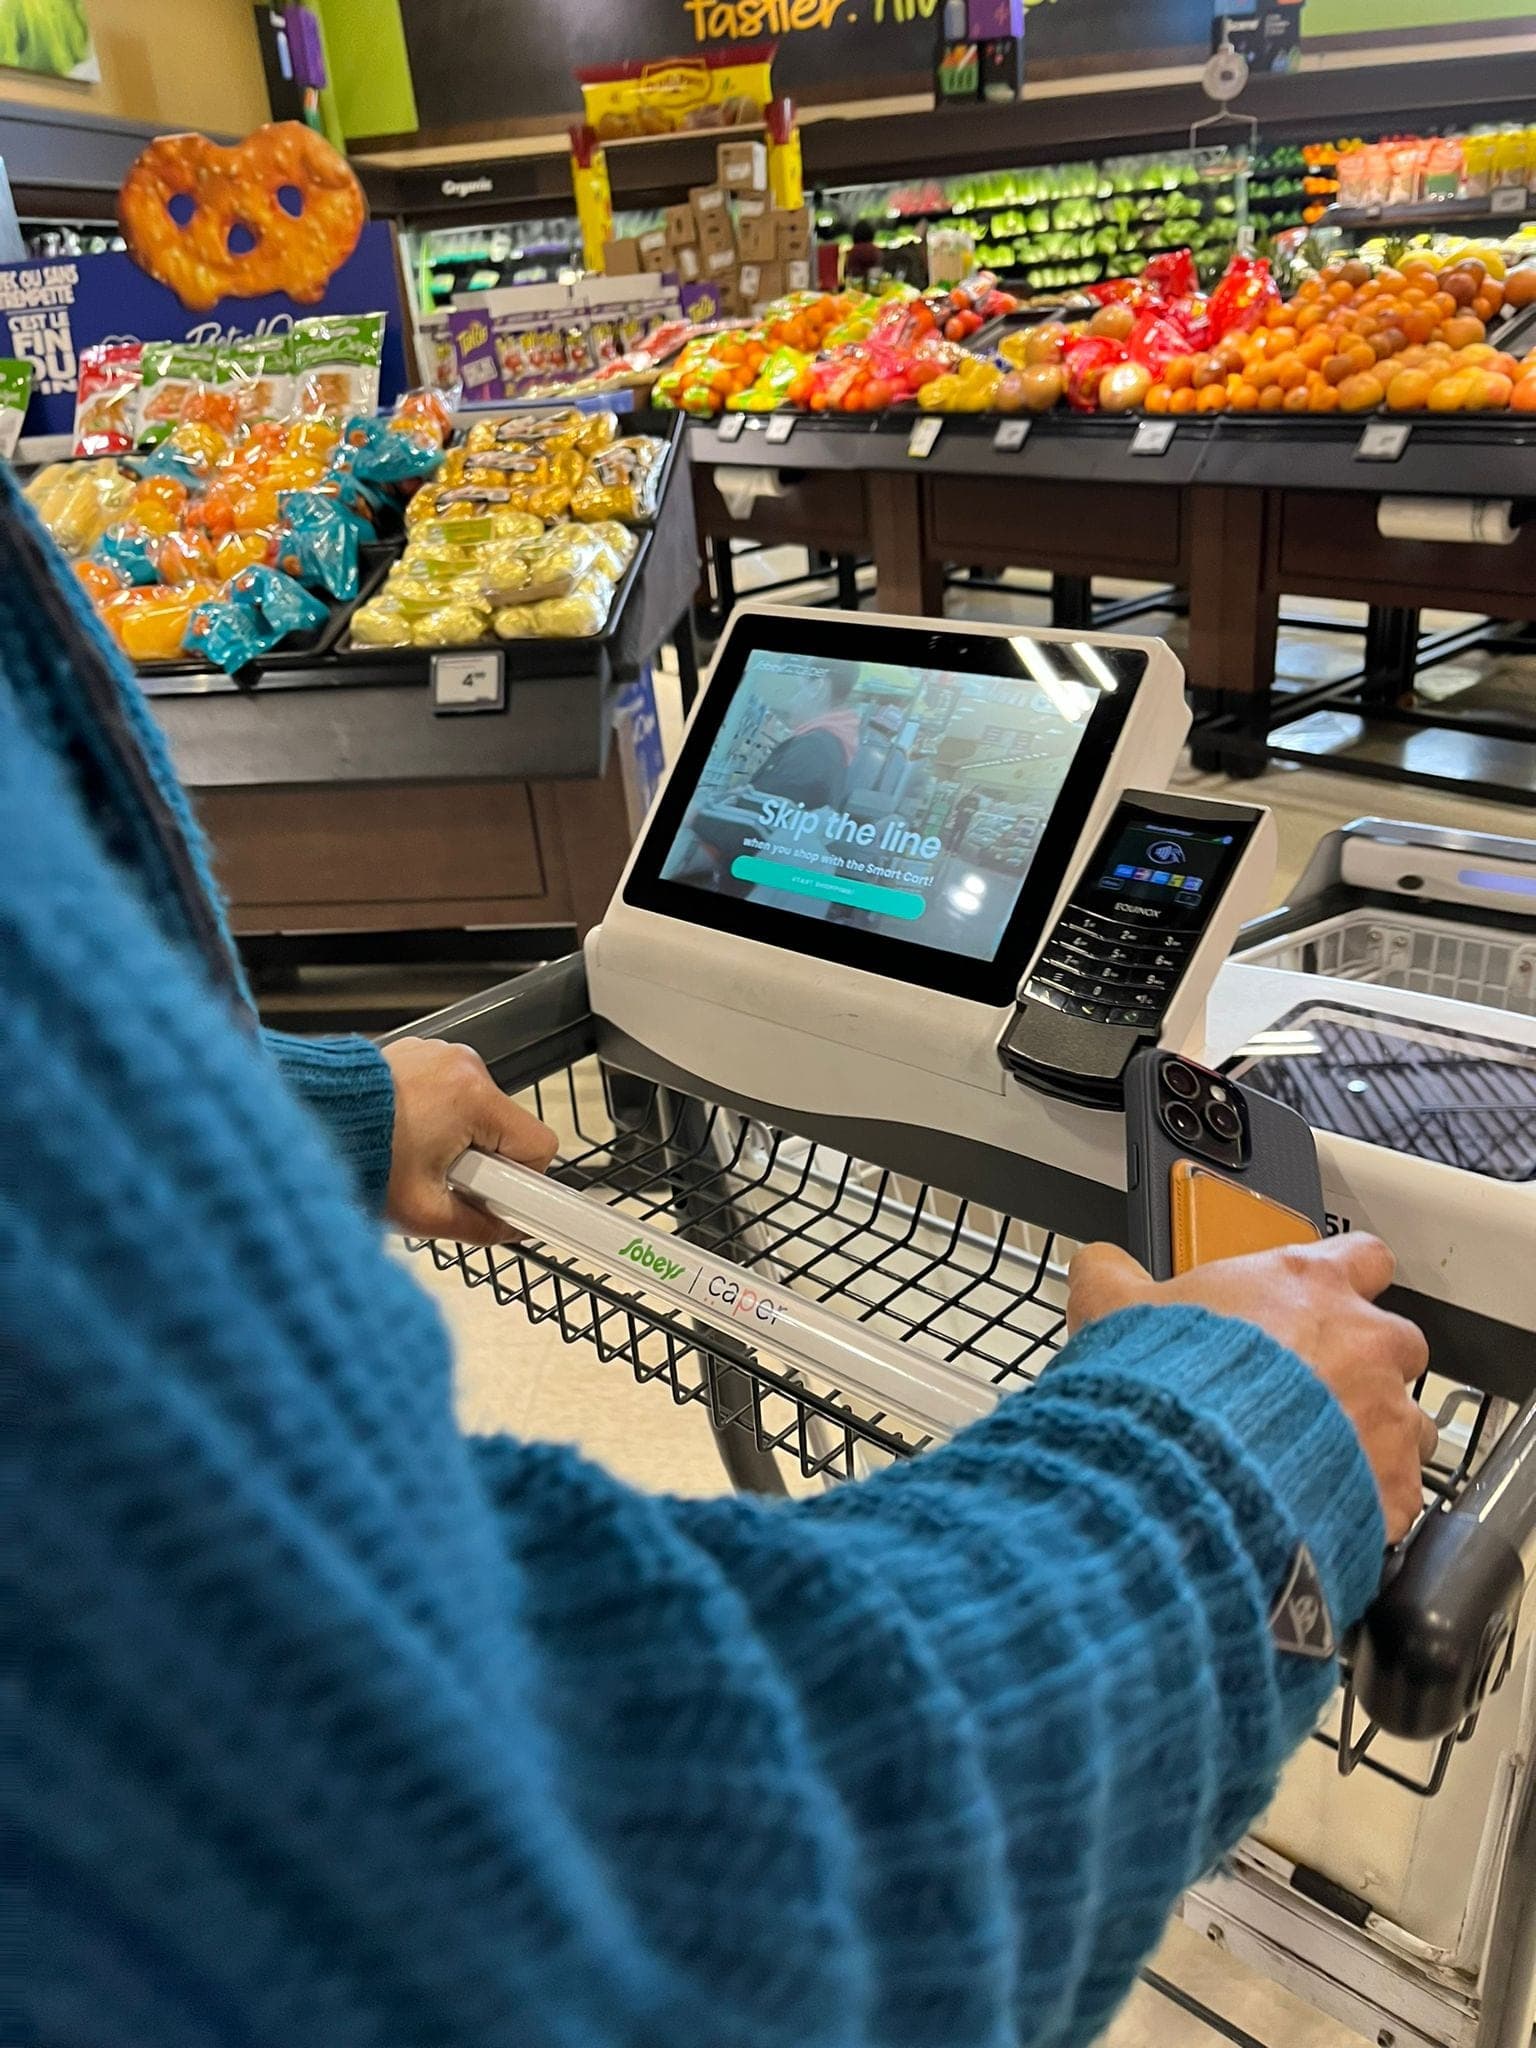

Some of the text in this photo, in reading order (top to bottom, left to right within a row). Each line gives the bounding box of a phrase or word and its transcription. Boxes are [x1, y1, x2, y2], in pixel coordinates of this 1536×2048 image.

[12, 327, 73, 360] FIN
[758, 798, 942, 860] Skip the line
[743, 837, 935, 887] when you shop with the Smart Cart!
[1114, 902, 1162, 918] EQUINOX
[618, 1237, 788, 1325] Sobeys caper
